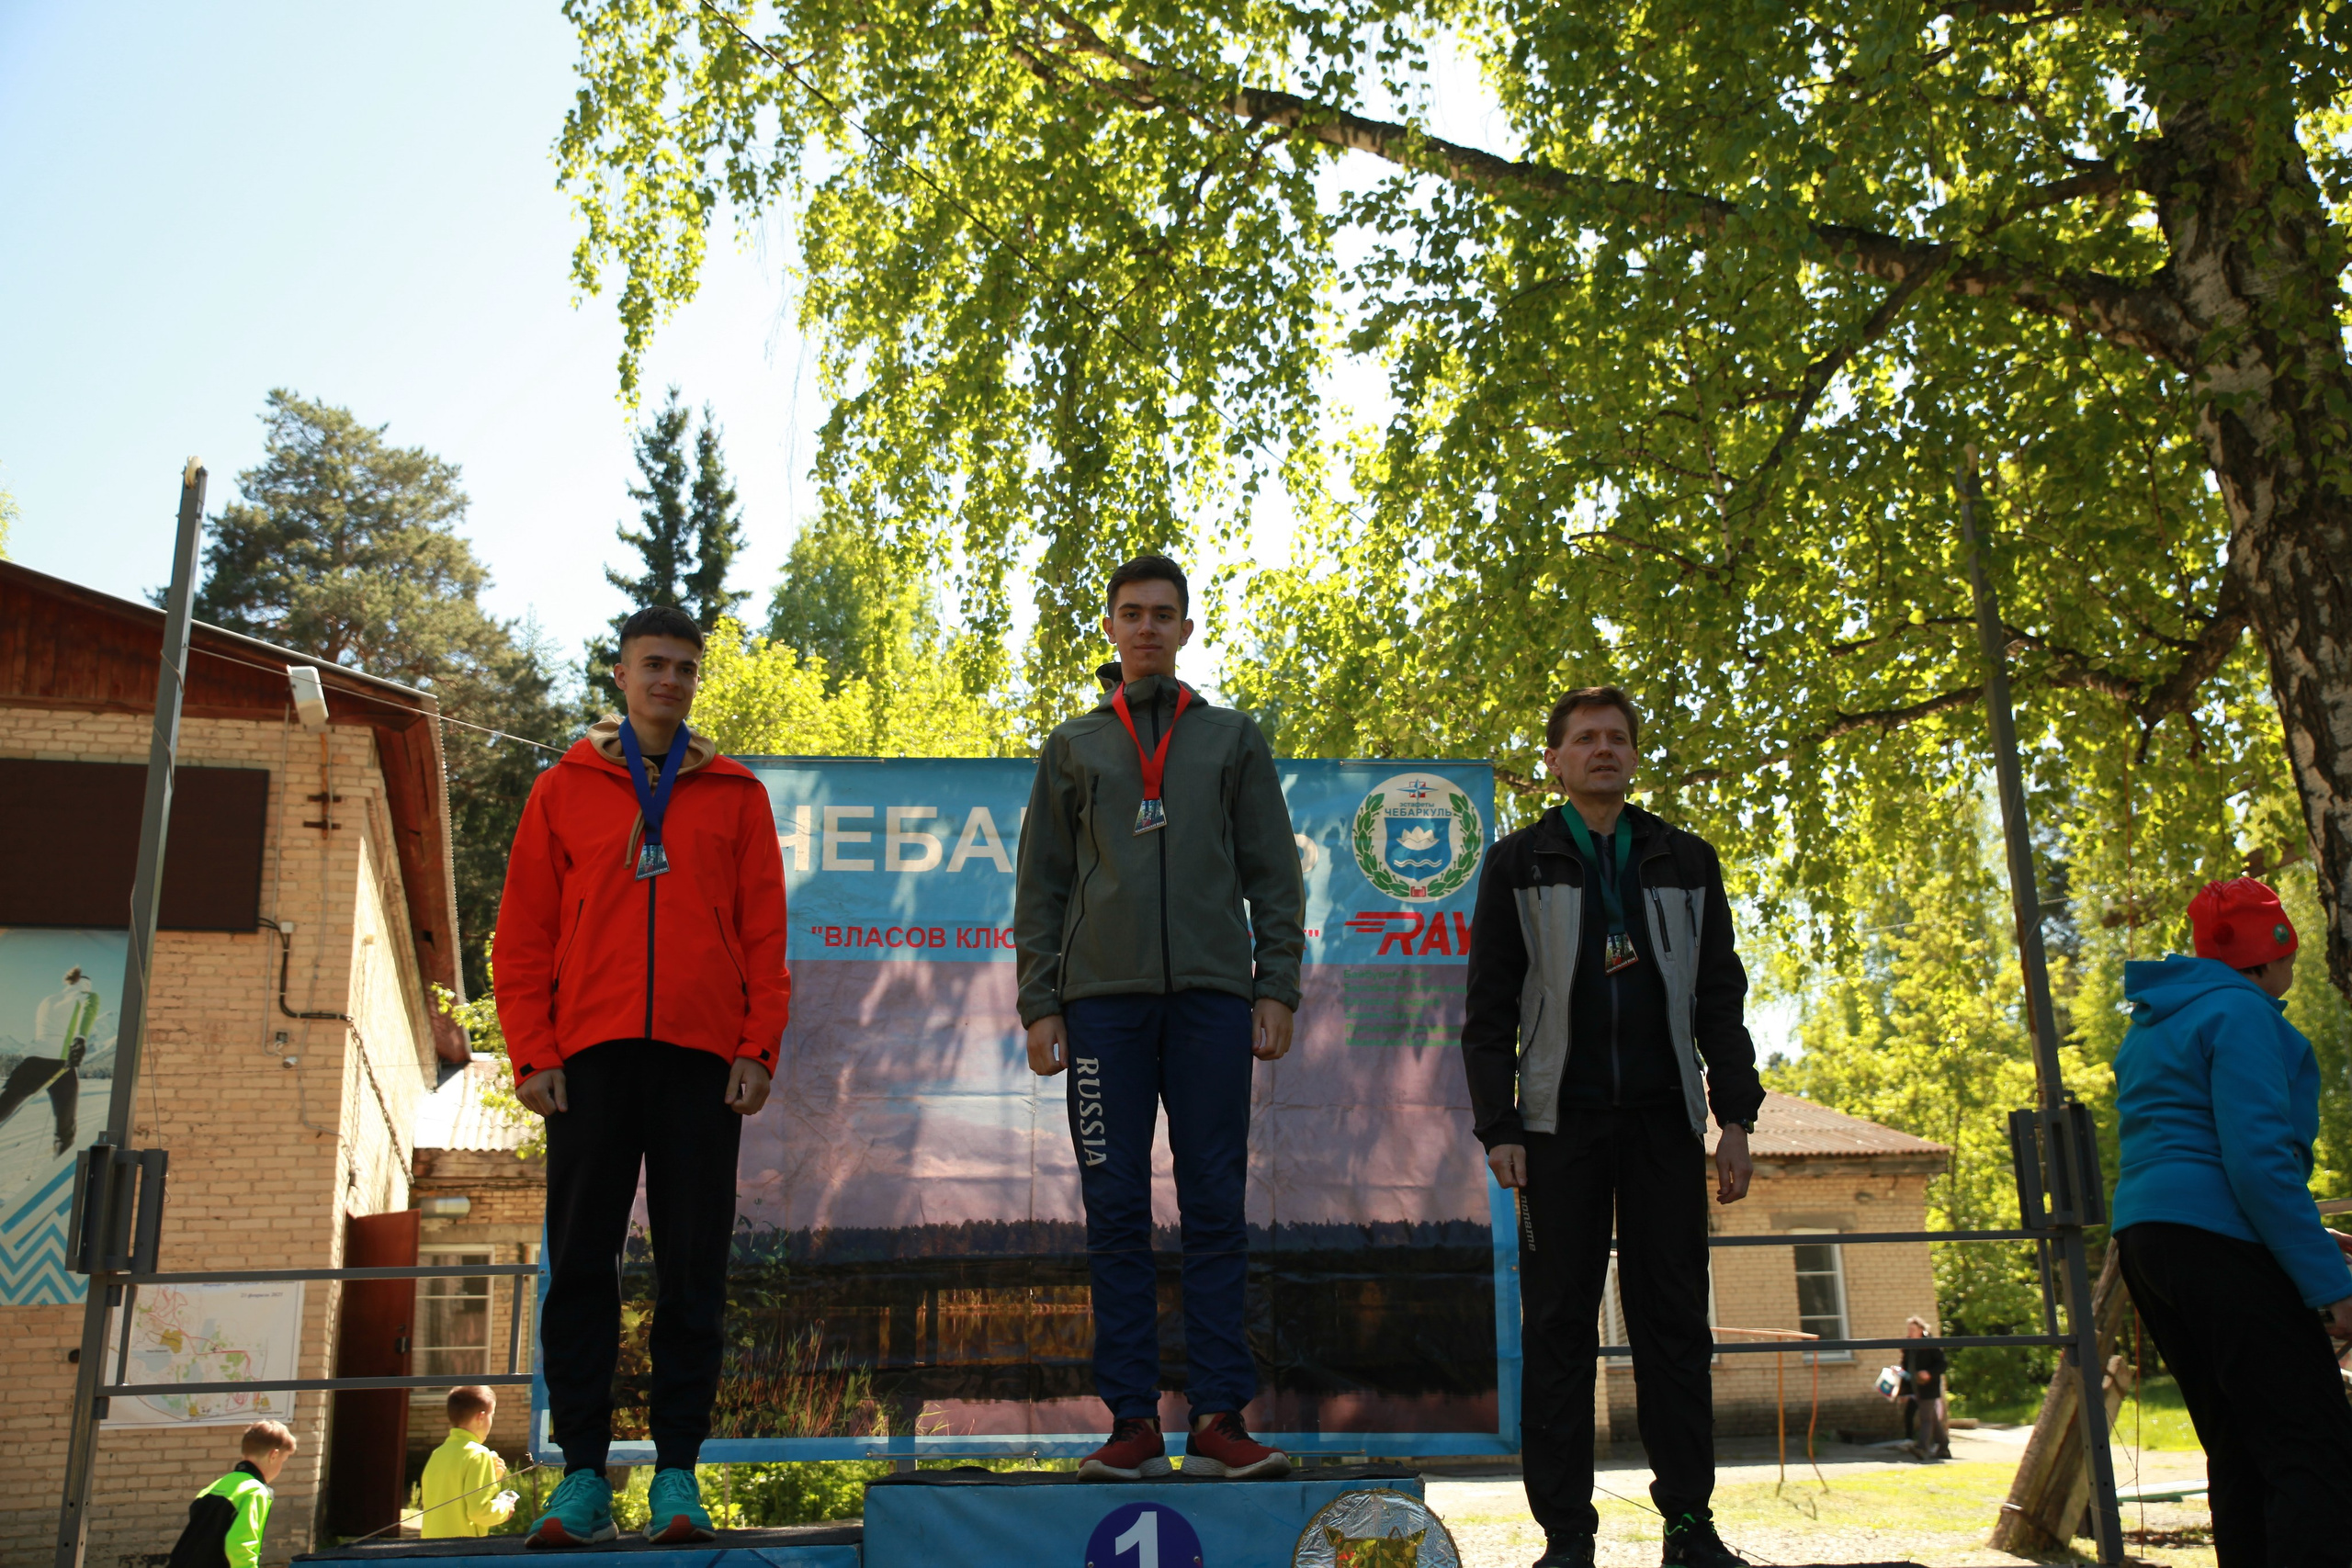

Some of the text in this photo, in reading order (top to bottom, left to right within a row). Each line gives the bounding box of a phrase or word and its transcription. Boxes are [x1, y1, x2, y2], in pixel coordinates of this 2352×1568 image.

[1385, 807, 1453, 817] ЧЕБАРКУЛЬ
[1398, 801, 1435, 809] эстафеты
[775, 805, 1027, 873] ЧЕБА
[810, 926, 1017, 949] "ВЛАСОВ КЛЮ
[1076, 1056, 1107, 1168] RUSSIA
[1521, 1194, 1537, 1252] noname
[1114, 1510, 1159, 1568] 1
